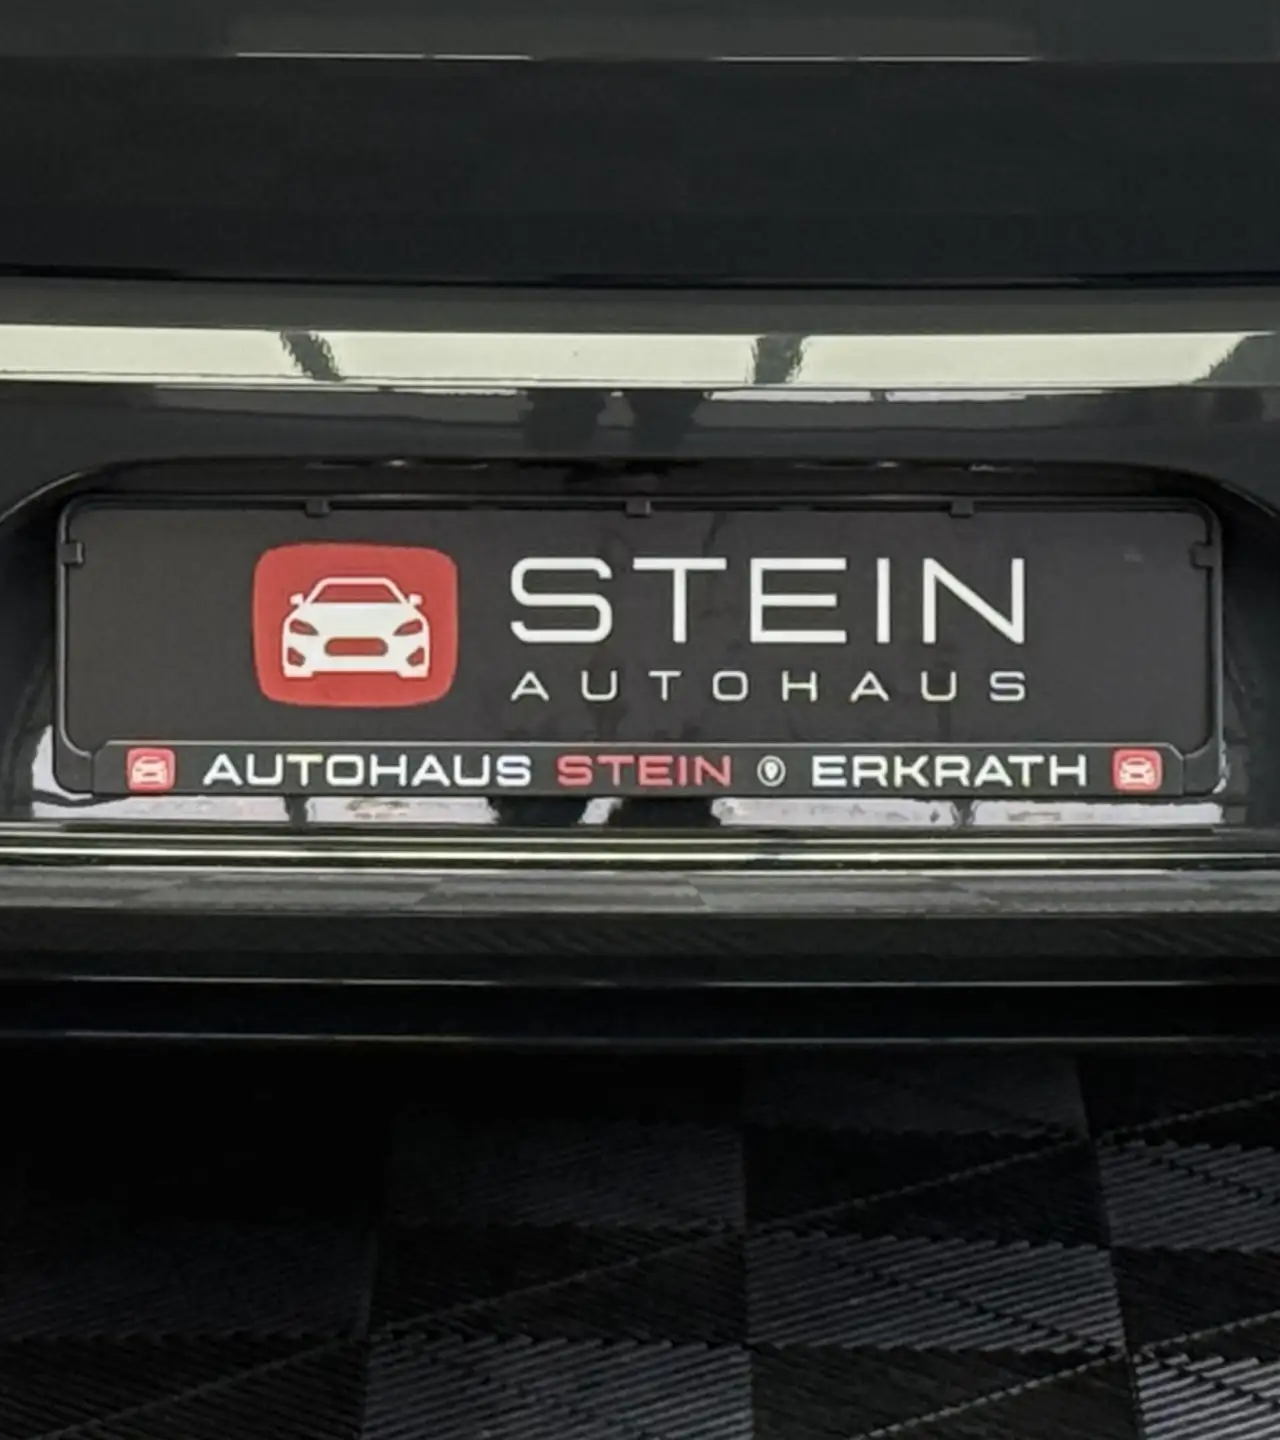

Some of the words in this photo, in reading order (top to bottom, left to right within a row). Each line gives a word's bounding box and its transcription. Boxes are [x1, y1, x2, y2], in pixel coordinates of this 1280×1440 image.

[509, 555, 1026, 646] STEIN
[509, 670, 1027, 704] AUTOHAUS
[202, 753, 533, 788] AUTOHAUS
[556, 754, 734, 788] STEIN
[811, 754, 1089, 789] ERKRATH
